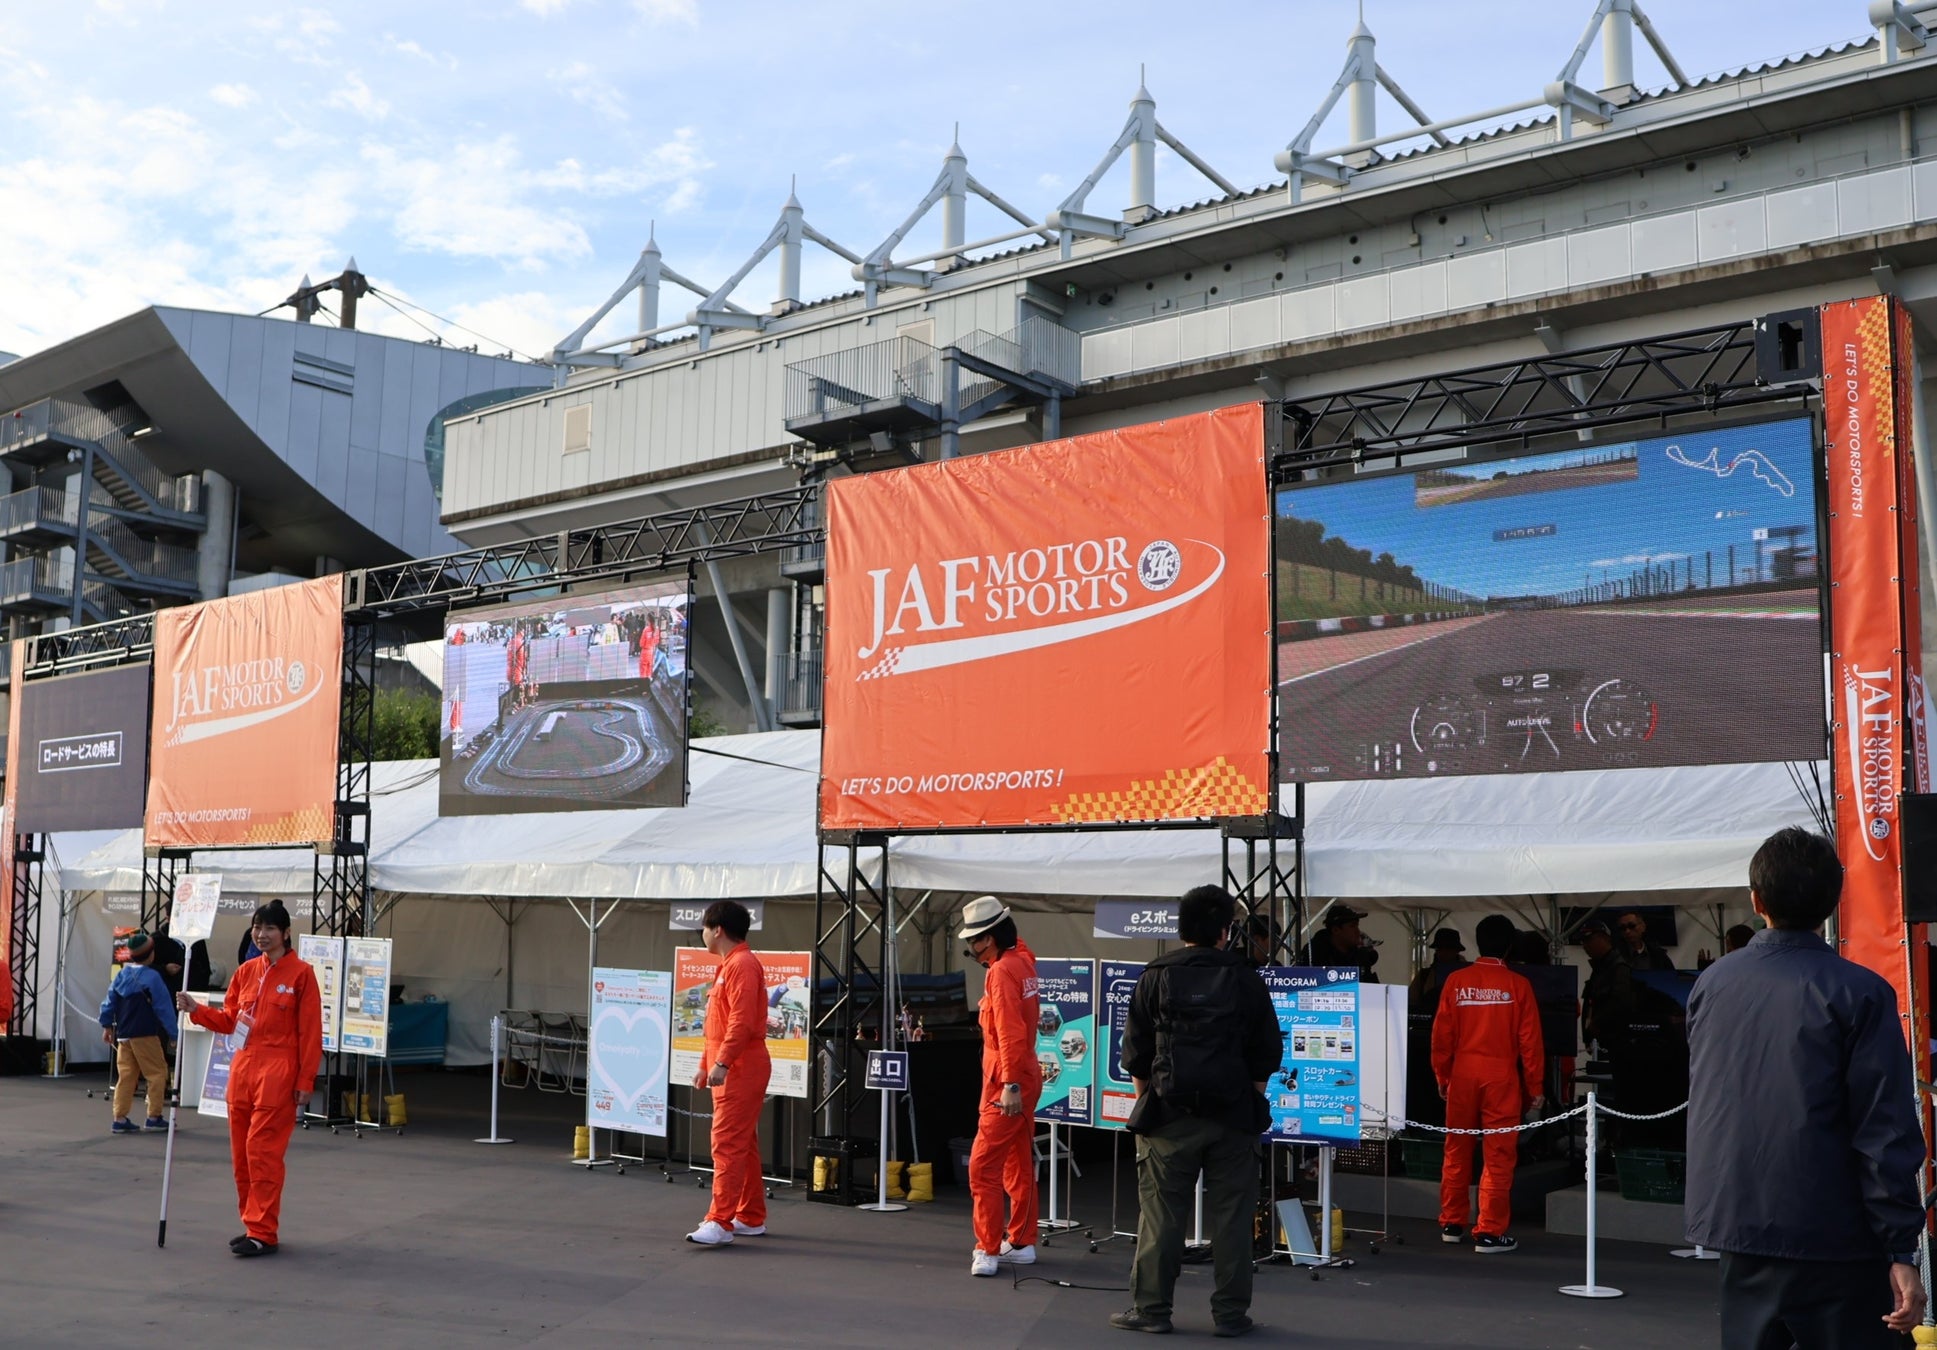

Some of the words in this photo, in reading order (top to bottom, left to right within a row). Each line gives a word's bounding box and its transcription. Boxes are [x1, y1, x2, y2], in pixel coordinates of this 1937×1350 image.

[1845, 343, 1857, 376] LET'S
[1846, 381, 1859, 403] DO
[984, 536, 1132, 587] MOTOR
[858, 556, 979, 659] JAF
[985, 572, 1128, 622] SPORTS
[222, 657, 285, 687] MOTOR
[1533, 674, 1549, 689] 2
[165, 666, 221, 733] JAF
[221, 680, 283, 710] SPORTS
[1852, 663, 1894, 734] JAF
[841, 777, 881, 796] LET'S
[885, 776, 913, 794] DO
[1863, 736, 1878, 814] SPORTS
[1878, 736, 1893, 815] MOTOR
[154, 812, 174, 825] LET'S
[174, 811, 187, 824] DO
[1274, 978, 1318, 987] PROGRAM
[1340, 971, 1357, 980] JAF
[1038, 991, 1089, 1004] ービスの特徴
[1455, 987, 1476, 1002] JAF
[871, 1058, 901, 1076] 出口
[1304, 1067, 1342, 1075] スロットカー
